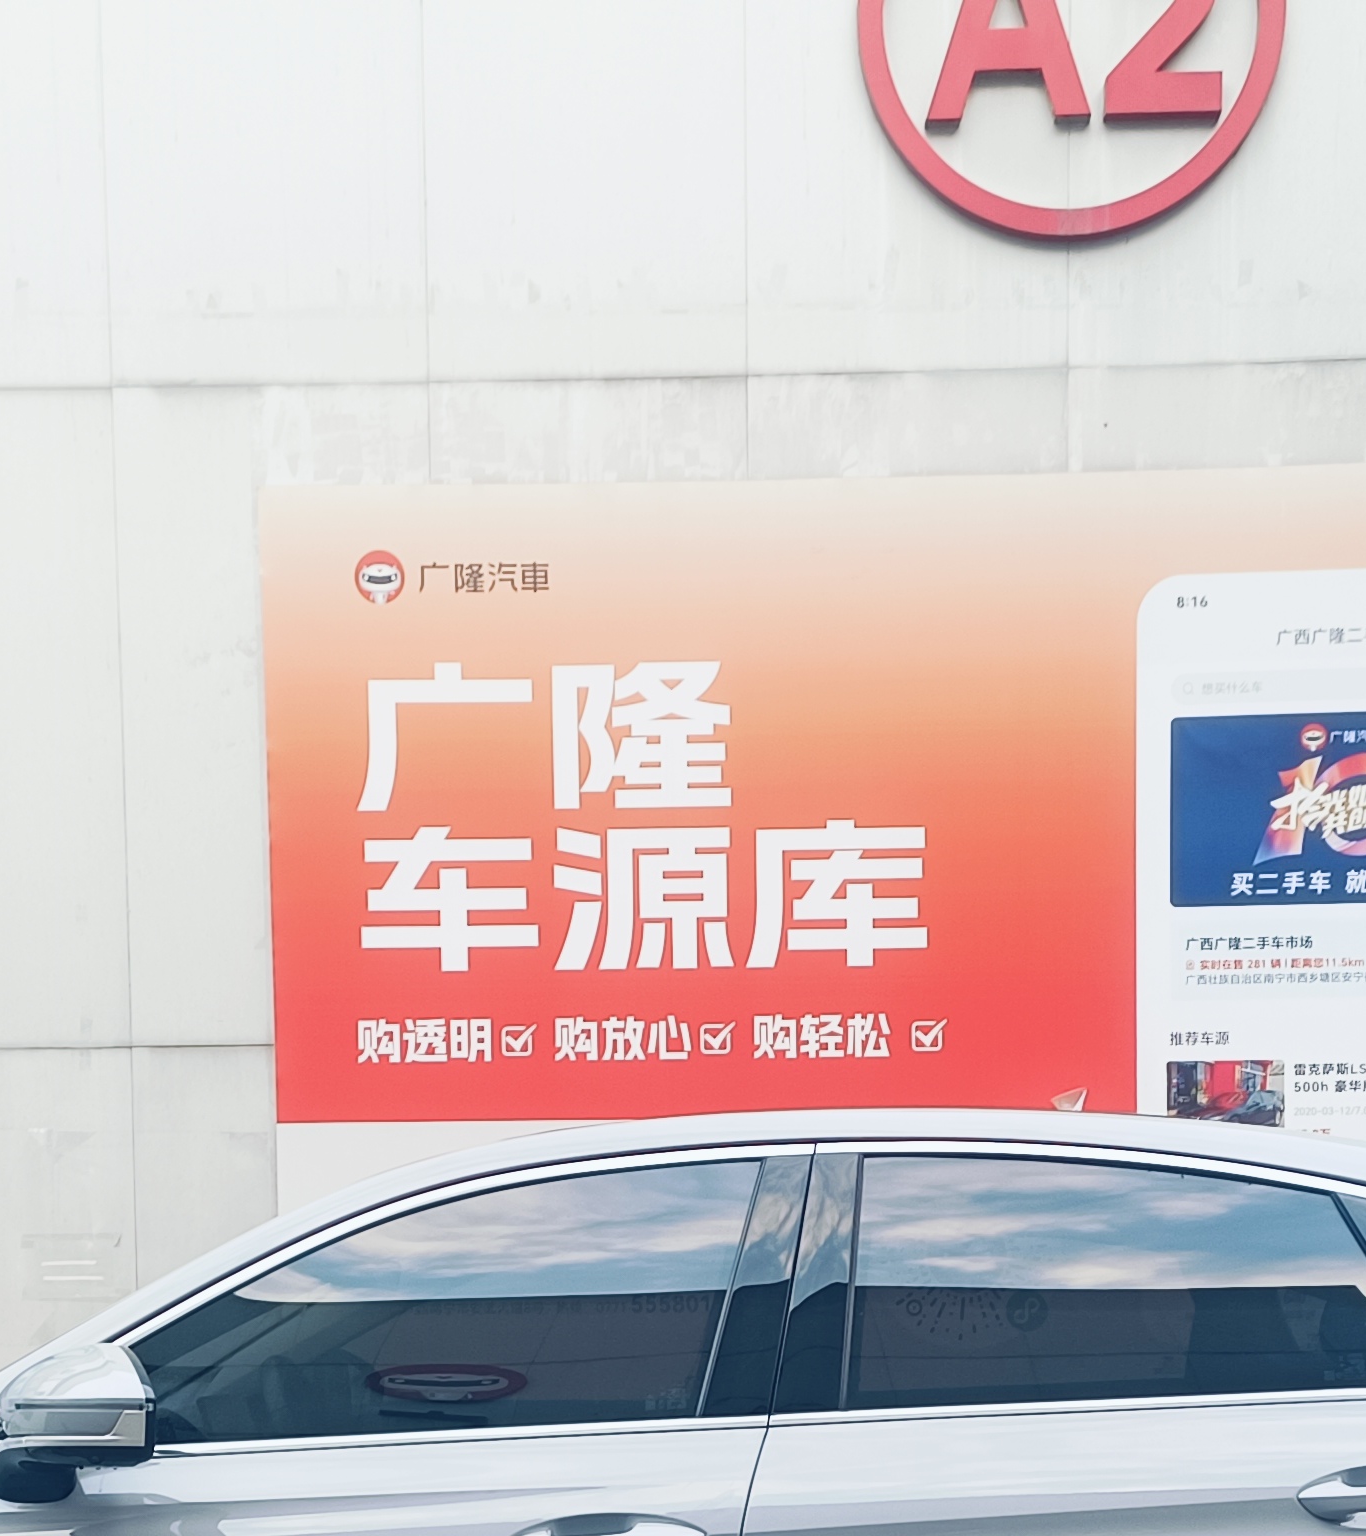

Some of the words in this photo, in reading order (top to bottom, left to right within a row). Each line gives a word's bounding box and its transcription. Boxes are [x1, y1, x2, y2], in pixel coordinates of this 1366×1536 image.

[925, 0, 1223, 131] A2
[1176, 595, 1208, 608] 8:16
[356, 661, 733, 811] 广隆
[1230, 869, 1332, 896] 买二手车
[360, 819, 928, 972] 车源库
[1186, 935, 1313, 950] 广西广隆二手车市场
[356, 1018, 493, 1064] 购透明
[553, 1015, 692, 1062] 购放心
[752, 1012, 891, 1060] 购轻松
[1170, 1031, 1230, 1046] 推荐车源
[1294, 1062, 1366, 1075] 雷克萨斯LS
[1294, 1081, 1329, 1092] 500h
